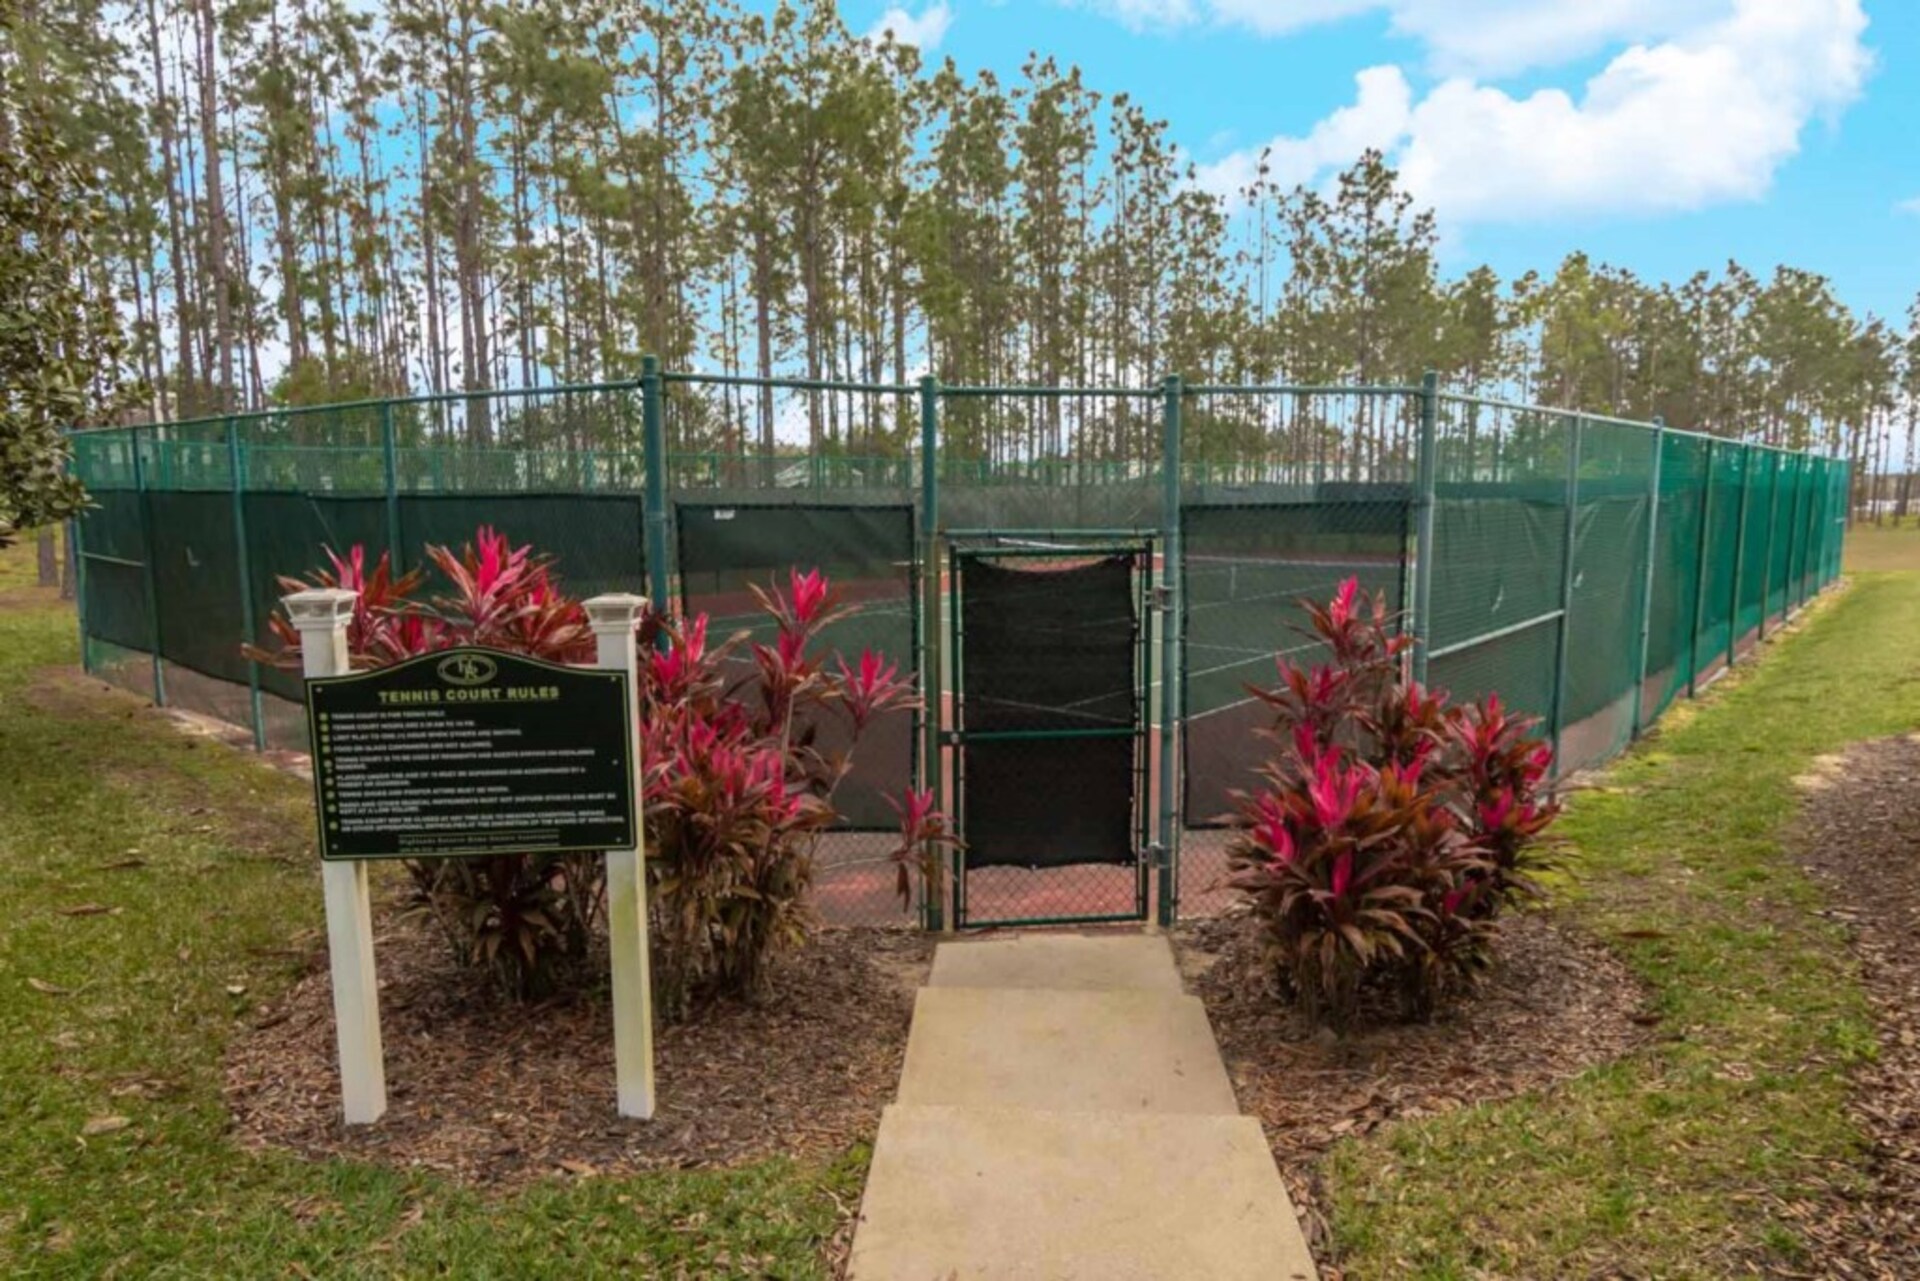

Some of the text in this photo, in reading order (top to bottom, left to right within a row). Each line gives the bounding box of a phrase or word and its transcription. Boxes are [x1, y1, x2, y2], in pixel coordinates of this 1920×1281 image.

[378, 686, 558, 703] TENNIS COURT RULES
